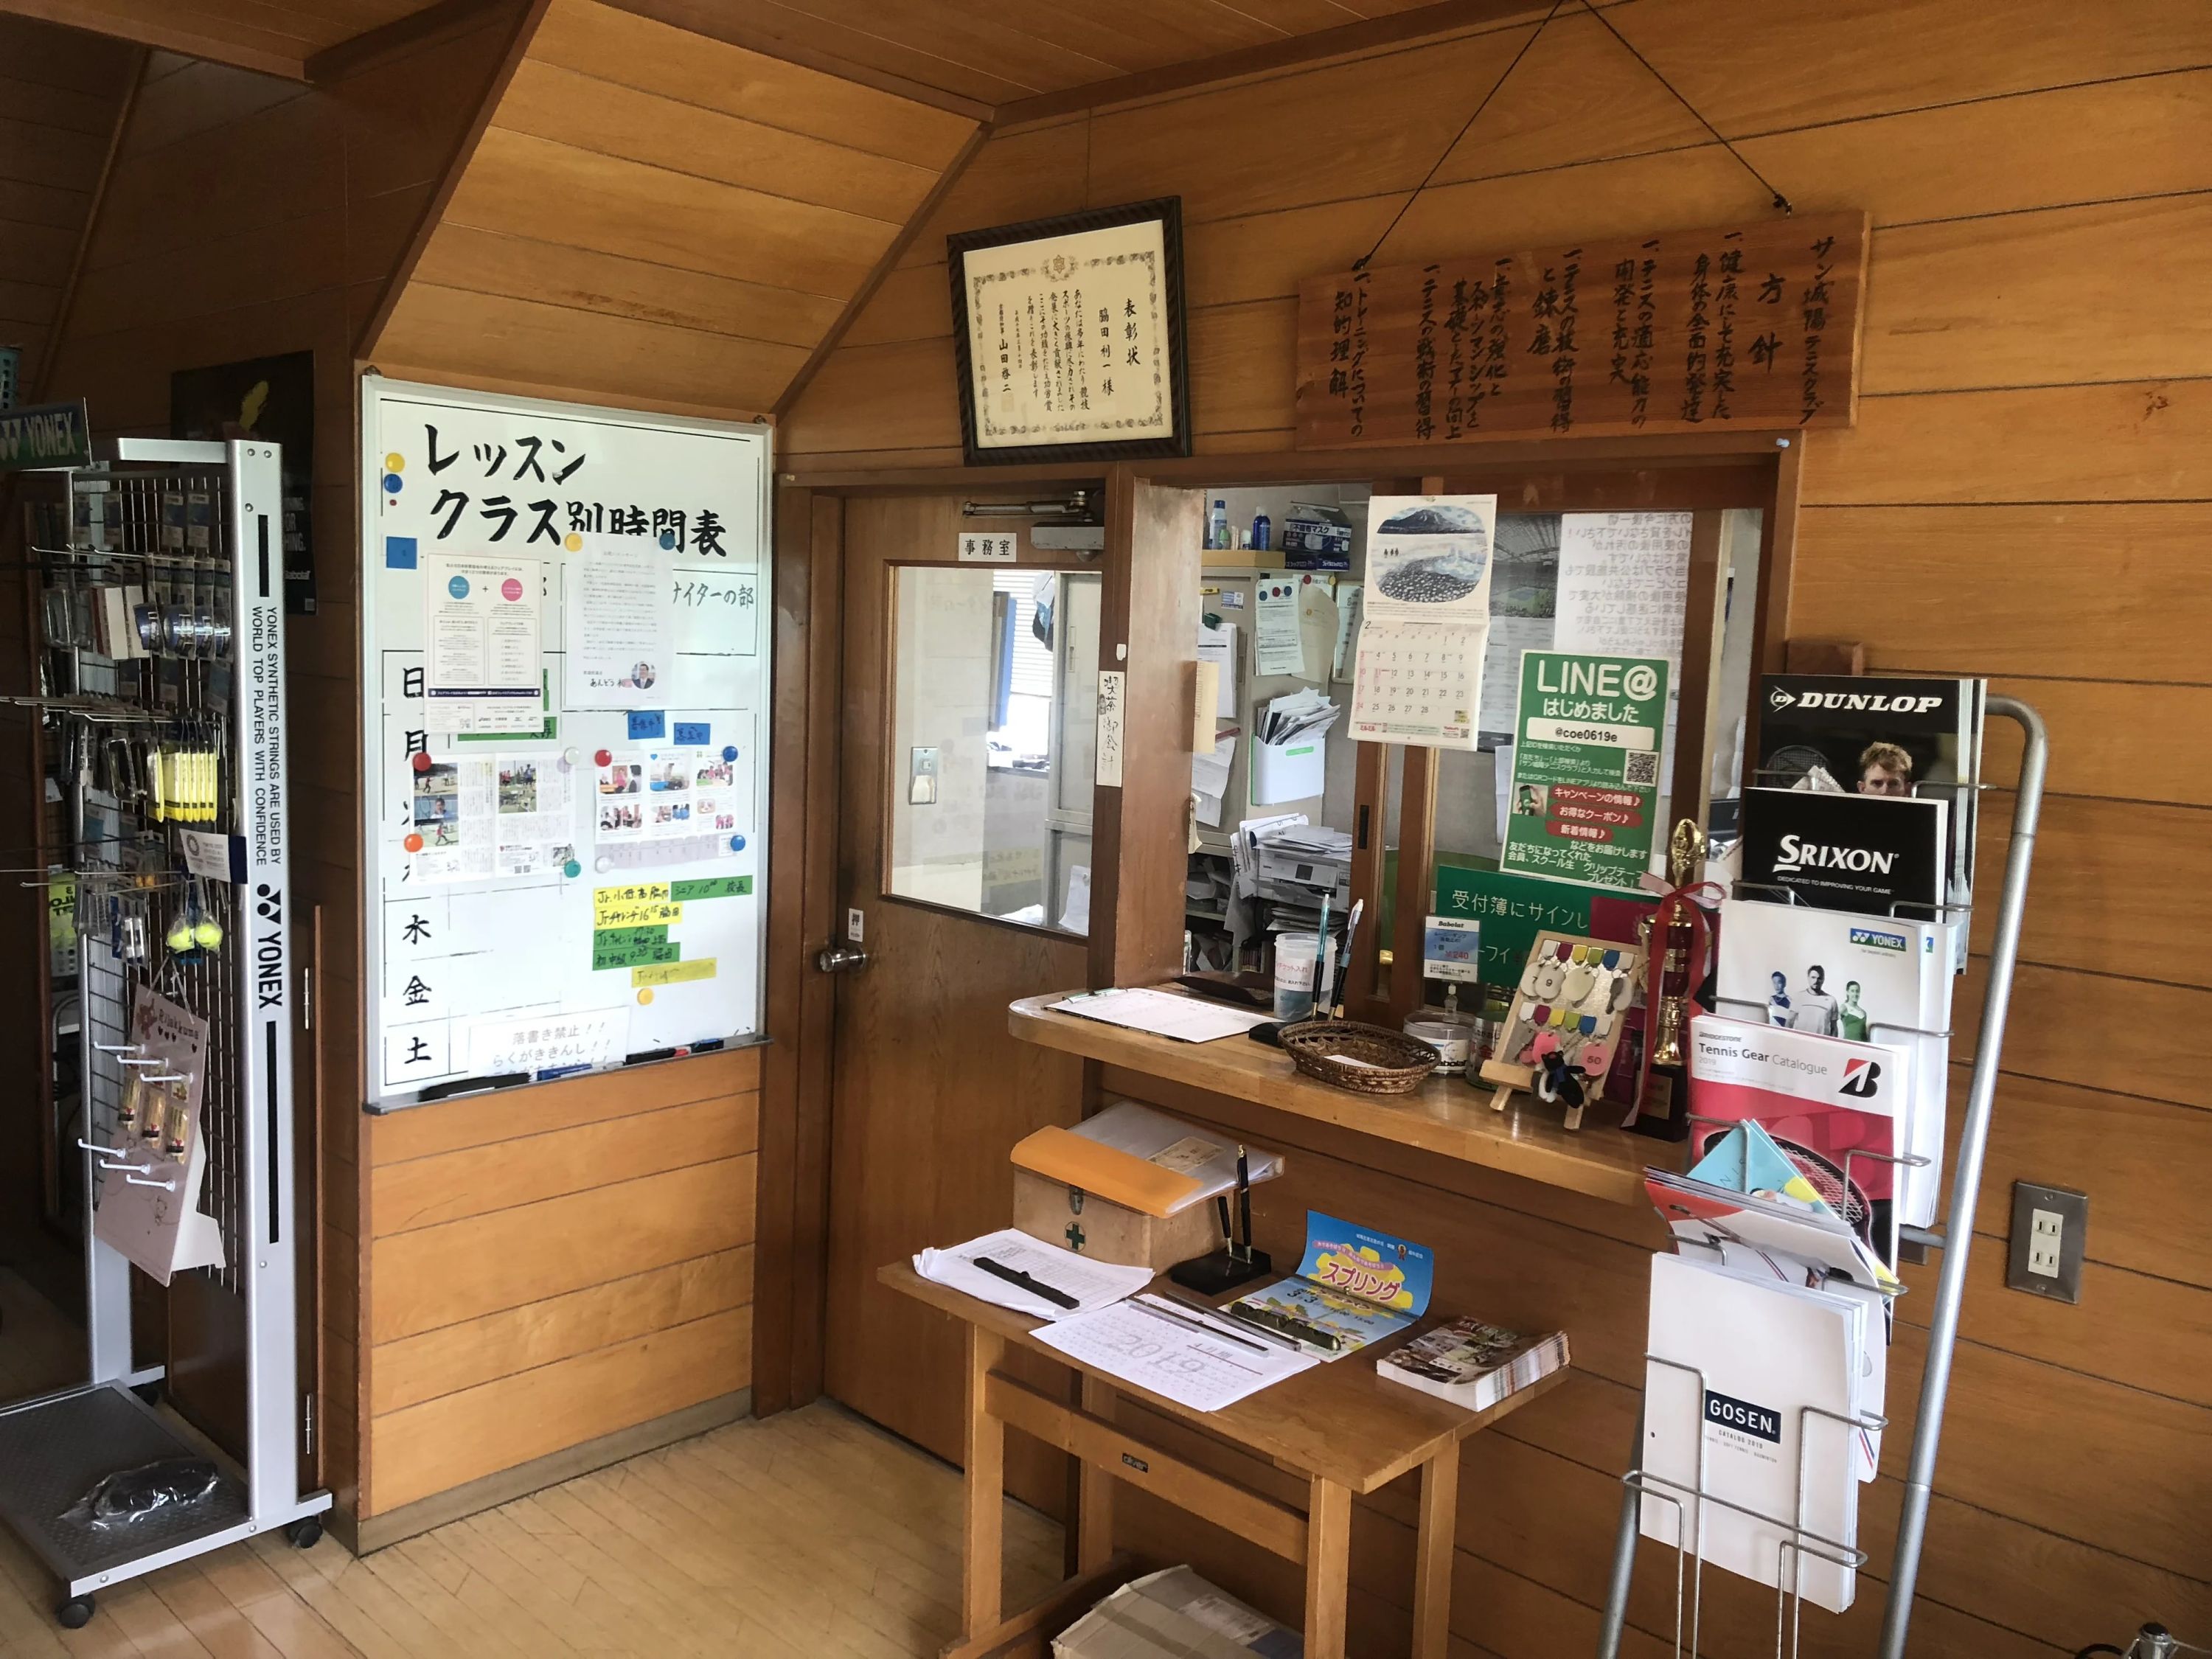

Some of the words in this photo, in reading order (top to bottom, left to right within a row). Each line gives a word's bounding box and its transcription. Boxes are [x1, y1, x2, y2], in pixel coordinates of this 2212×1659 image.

[1123, 298, 1141, 366] 表彰状
[1747, 272, 1785, 374] 方針
[1799, 236, 1836, 425] サン城陽テニスクラブ
[1329, 290, 1353, 398] 知的理解
[24, 411, 77, 458] YONEX
[424, 424, 586, 484] レッスン
[964, 539, 1010, 557] 事務室
[252, 607, 263, 652] WORLD
[266, 607, 278, 649] YONEX
[253, 659, 264, 684] TOP
[268, 654, 279, 722] SYNTHETIC
[403, 666, 424, 699] 日
[1537, 659, 1658, 701] LINE@
[254, 689, 265, 744] PLAYERS
[1543, 698, 1639, 723] はじめました
[1798, 692, 1943, 713] DUNLOP
[1556, 727, 1617, 742] @coe0619e
[254, 750, 265, 781] WITH
[268, 727, 279, 780] STRINGS
[270, 784, 280, 808] ARE
[255, 787, 266, 866] CONFIDENCE
[270, 813, 281, 846] USED
[271, 849, 281, 865] BY
[1509, 841, 1592, 862] 友だちになってくれた
[1778, 835, 1894, 874] SRIXON
[1778, 875, 1809, 885] DEDICATED
[1820, 880, 1854, 891] IMPROVING
[1855, 885, 1872, 893] YOUR
[1874, 887, 1891, 895] GAME
[1452, 889, 1587, 929] 受付簿にサインし
[403, 914, 431, 945] 木
[1871, 934, 1903, 949] YONEX
[257, 931, 282, 1009] YONEX
[403, 975, 431, 1006] 金
[403, 1037, 432, 1065] 土
[1587, 1056, 1601, 1065] 50
[1699, 1043, 1738, 1057] Tennis
[1742, 1049, 1770, 1062] Gear
[1772, 1054, 1828, 1075] Catalogue
[1321, 1261, 1401, 1301] スプリング
[1710, 1399, 1773, 1433] GOSEN
[1719, 1429, 1745, 1443] CATALOG
